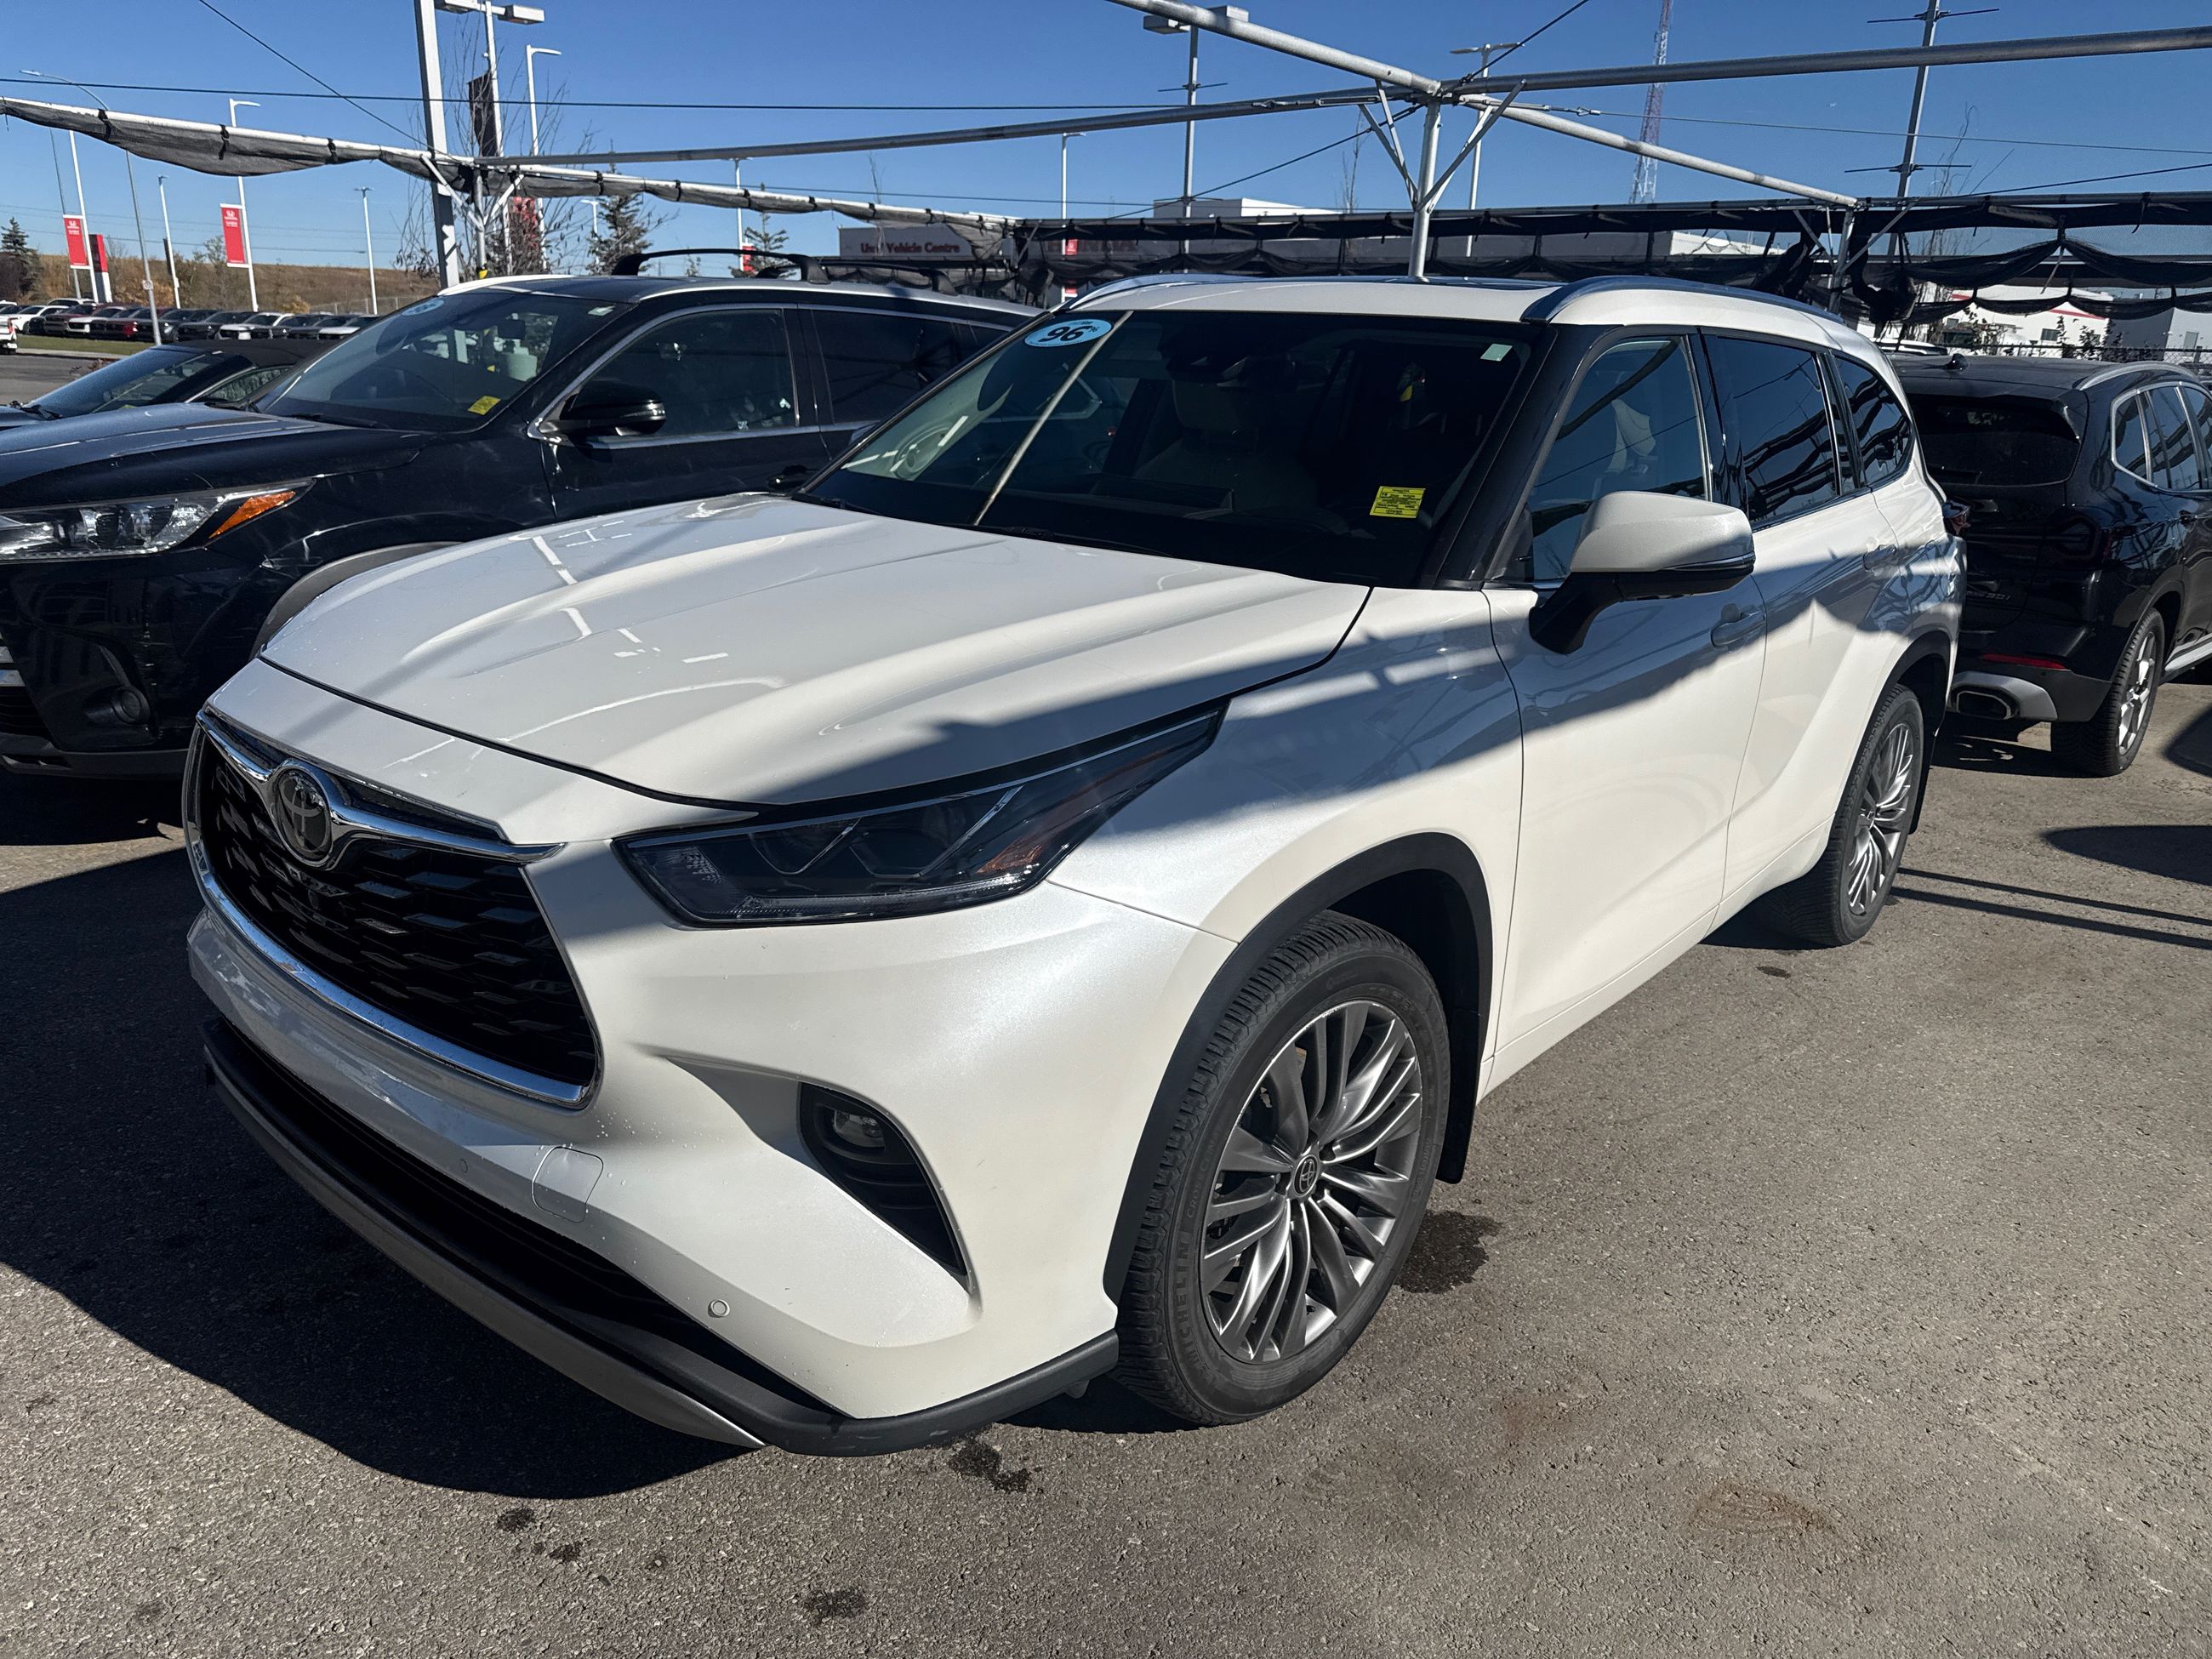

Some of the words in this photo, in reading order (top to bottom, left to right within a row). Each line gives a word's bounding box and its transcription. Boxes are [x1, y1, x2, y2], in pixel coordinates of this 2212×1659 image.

[887, 242, 921, 254] Vehicle
[925, 242, 960, 254] Centre
[1177, 1241, 1200, 1364] MICHELIN
